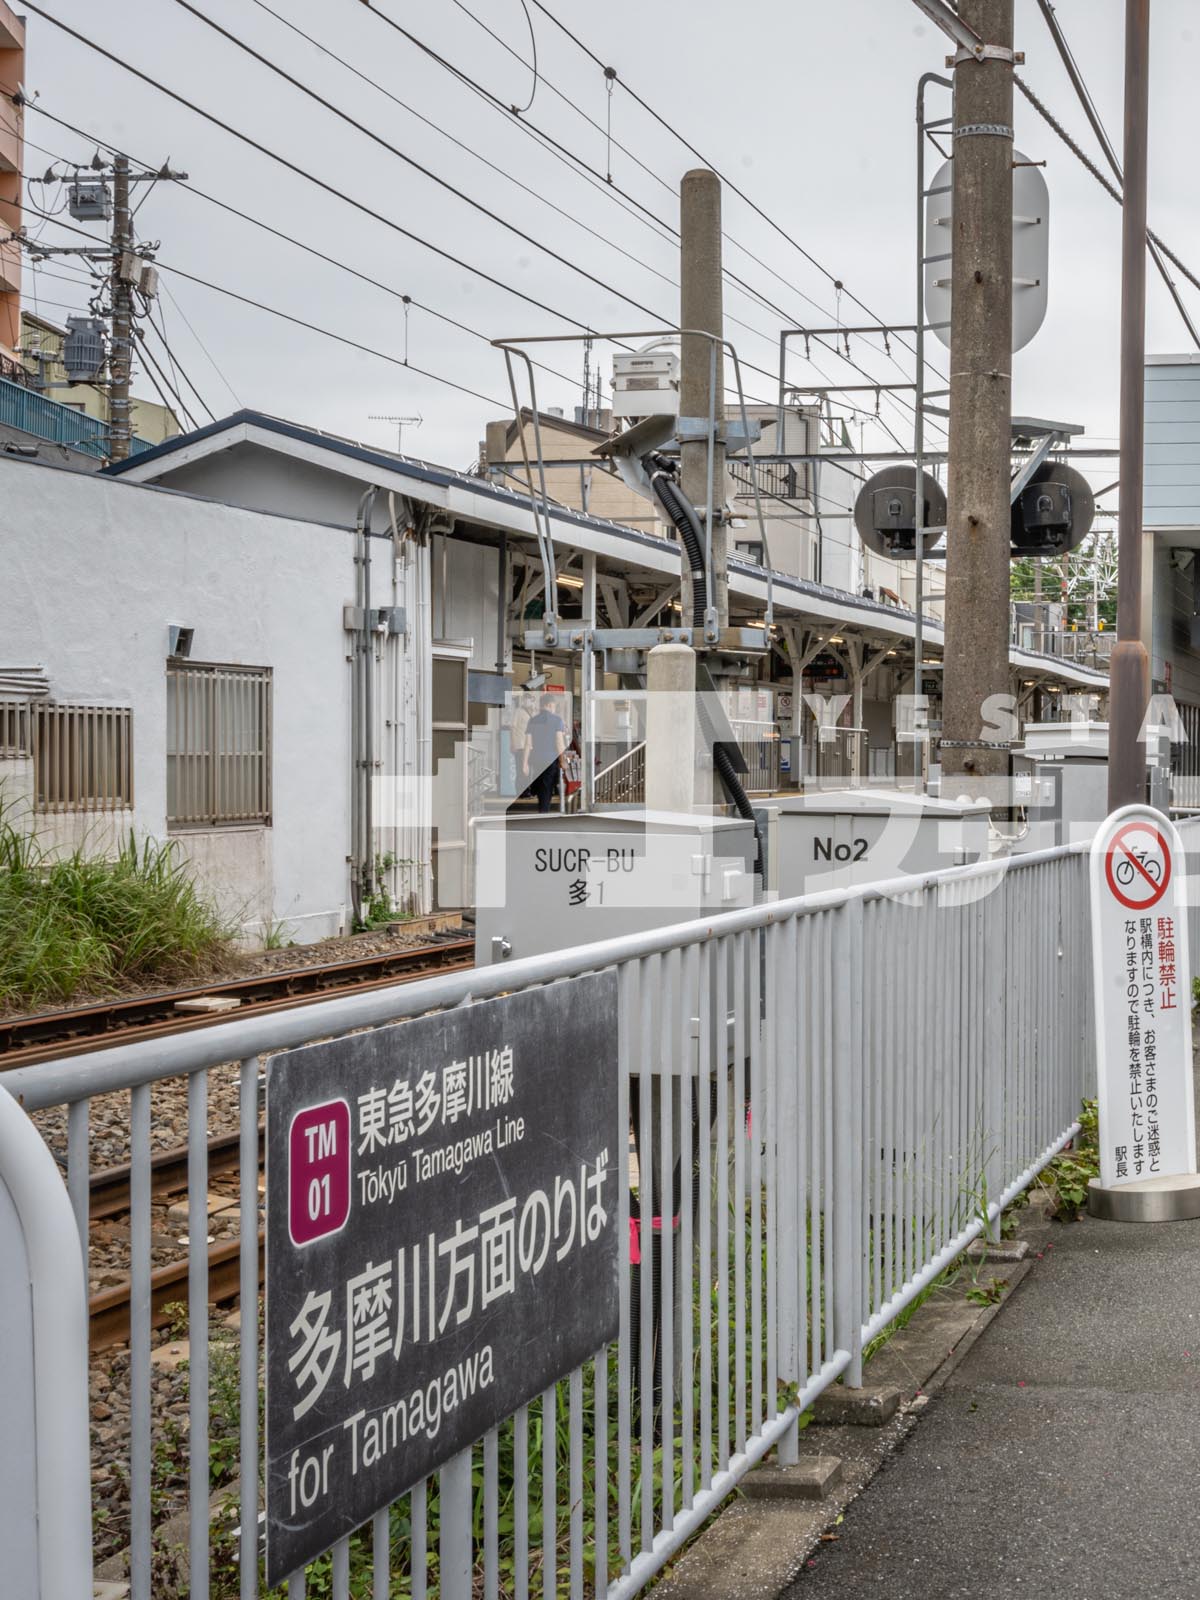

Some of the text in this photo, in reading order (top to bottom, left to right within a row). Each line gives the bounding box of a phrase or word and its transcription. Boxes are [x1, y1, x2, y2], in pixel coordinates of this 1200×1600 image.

[535, 848, 635, 873] SUCR-BU
[813, 836, 869, 862] No2
[1157, 916, 1177, 1010] 駐輪禁止
[1124, 919, 1143, 1175] なりますので駐輪を禁止いたします
[305, 1120, 337, 1164] TM
[357, 1045, 514, 1156] 東急多摩川線
[308, 1174, 331, 1221] 01
[357, 1117, 525, 1206] Tōkyū Tamagawa Line
[1115, 1146, 1128, 1178] 駅長
[288, 1148, 609, 1422] 多摩川方面のりば
[288, 1344, 495, 1517] for Tamagawa
